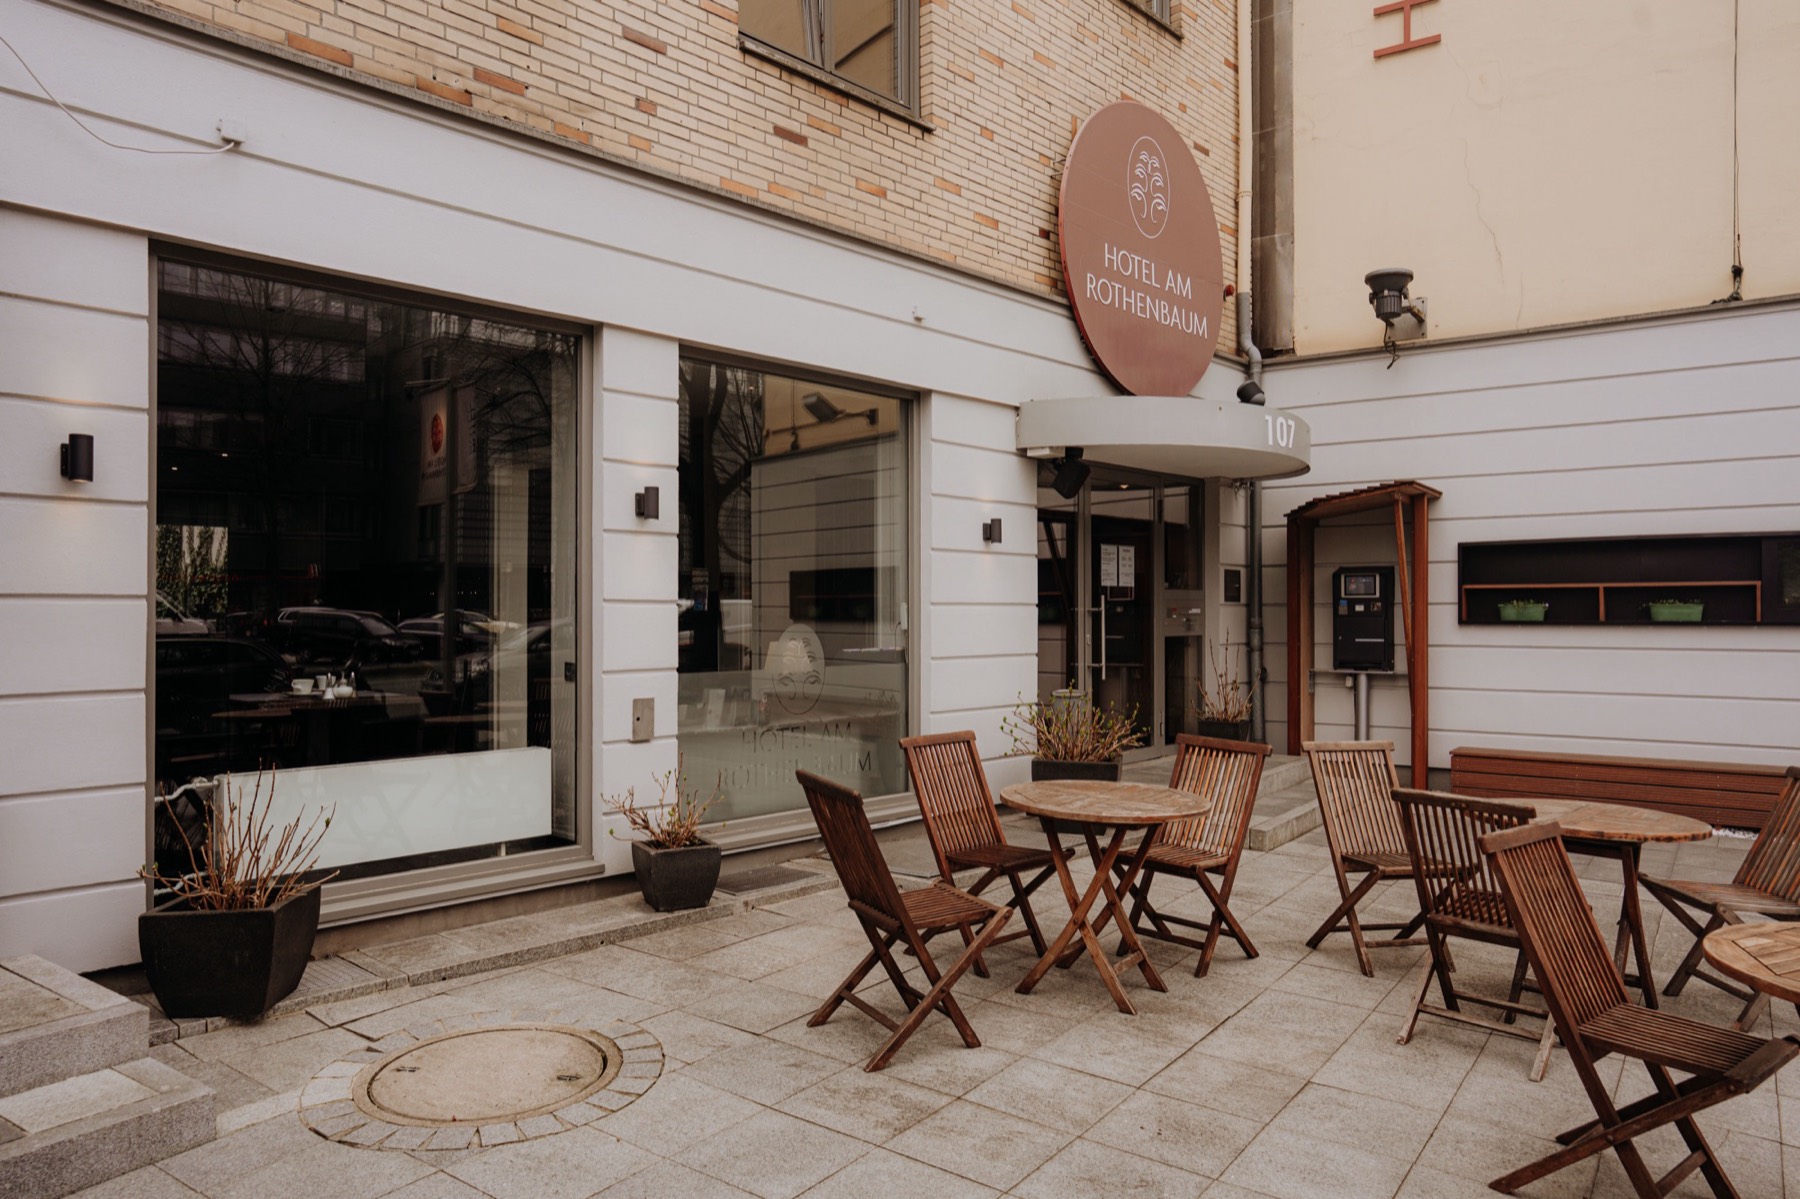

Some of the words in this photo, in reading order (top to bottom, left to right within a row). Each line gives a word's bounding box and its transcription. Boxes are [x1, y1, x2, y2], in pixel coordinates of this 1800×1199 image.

[1104, 243, 1161, 288] HOTEL
[1165, 269, 1192, 299] AM
[1086, 273, 1208, 339] ROTHENBAUM
[1264, 415, 1296, 448] 107
